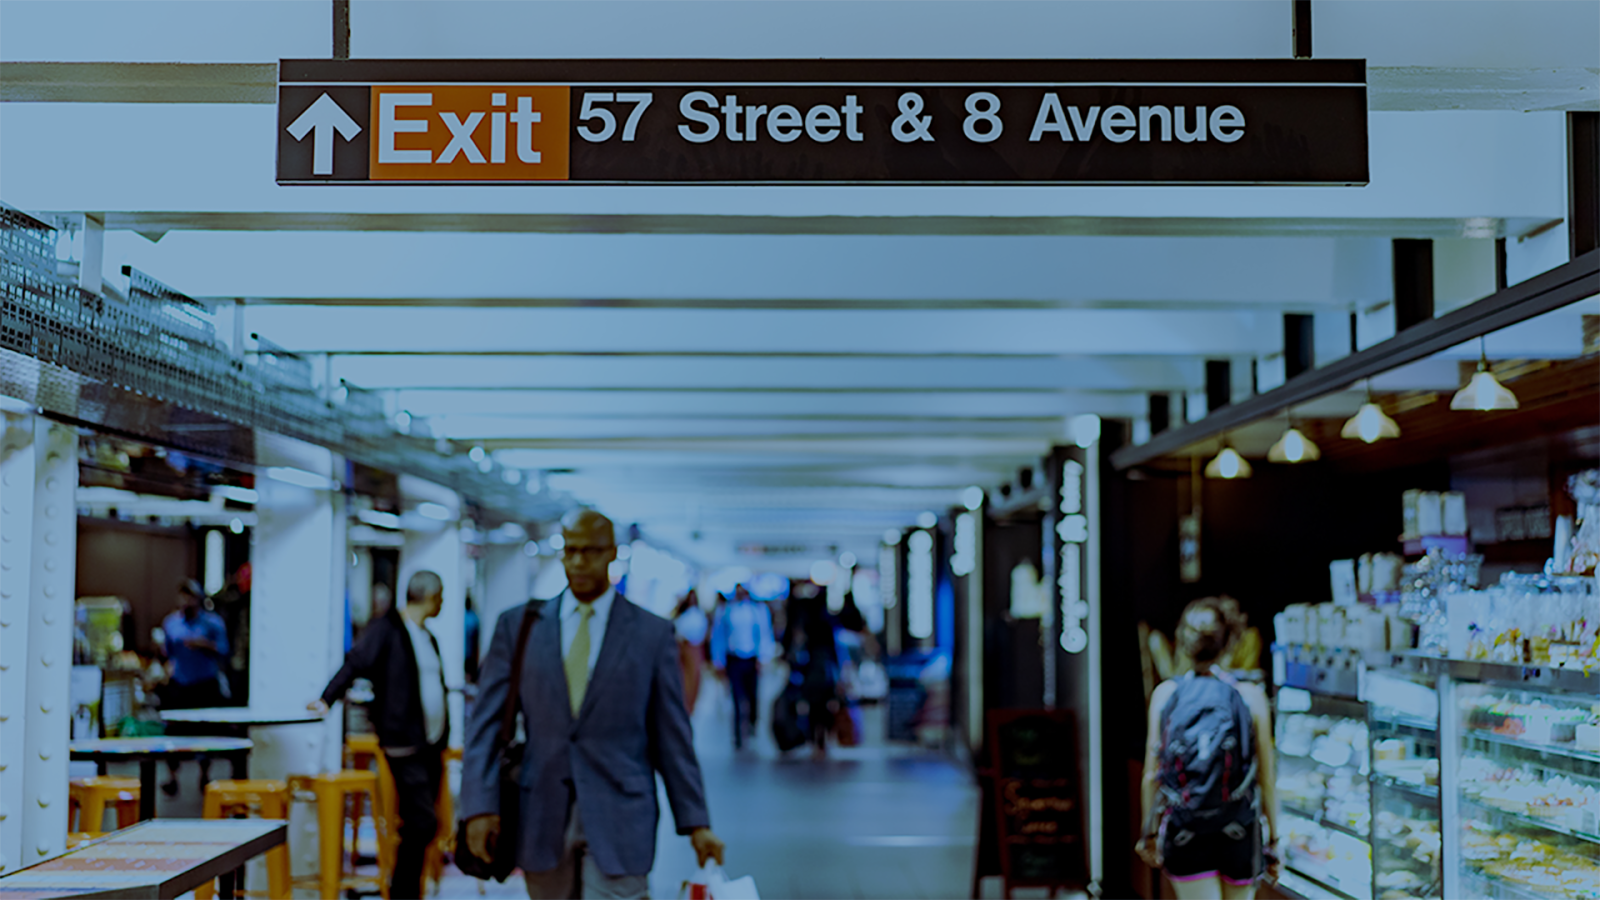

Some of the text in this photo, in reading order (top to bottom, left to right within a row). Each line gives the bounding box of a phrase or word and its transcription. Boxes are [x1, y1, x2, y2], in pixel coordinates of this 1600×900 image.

[378, 91, 1246, 164] Exit 57 Street & 8 Avenue
